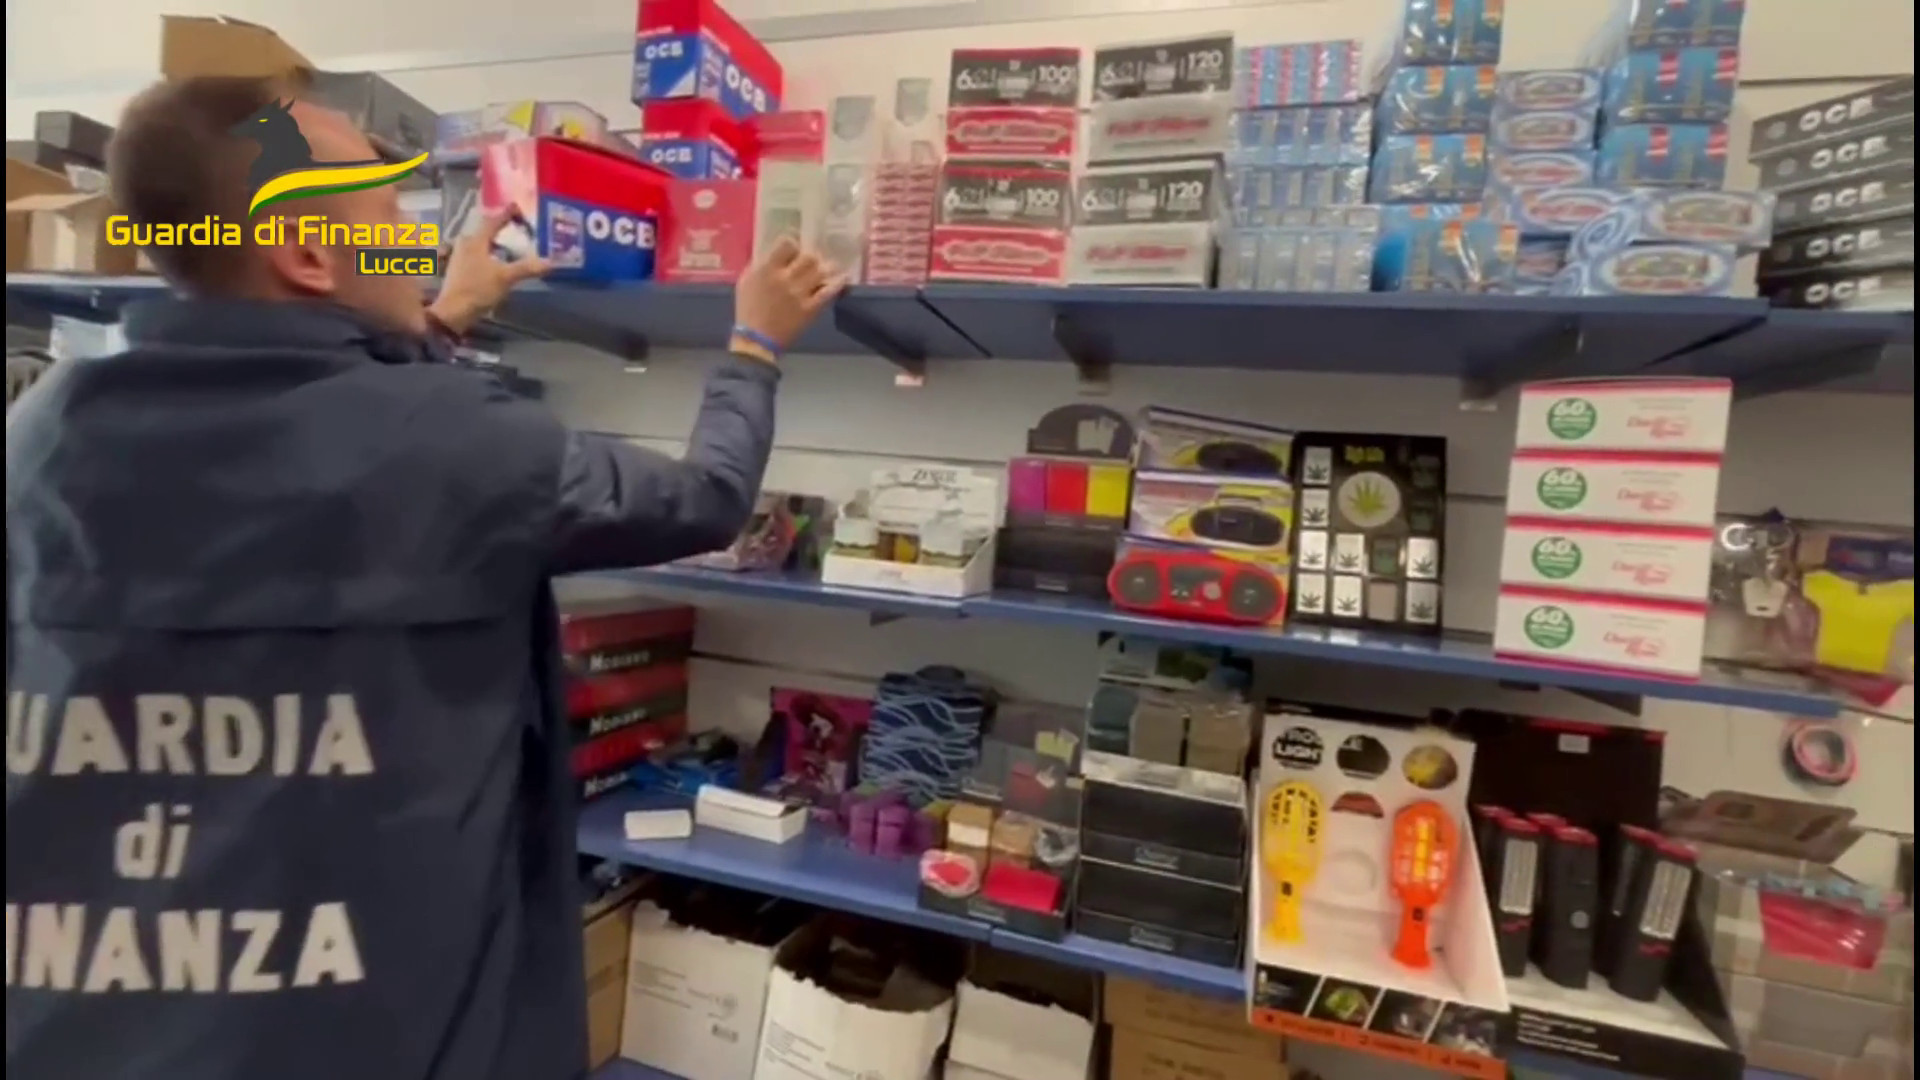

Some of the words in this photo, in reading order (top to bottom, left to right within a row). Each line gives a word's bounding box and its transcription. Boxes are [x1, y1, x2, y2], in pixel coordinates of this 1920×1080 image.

[645, 41, 683, 59] OCB
[726, 63, 766, 113] OCB
[651, 147, 692, 164] OCB
[586, 210, 655, 250] OCB
[114, 803, 192, 880] di
